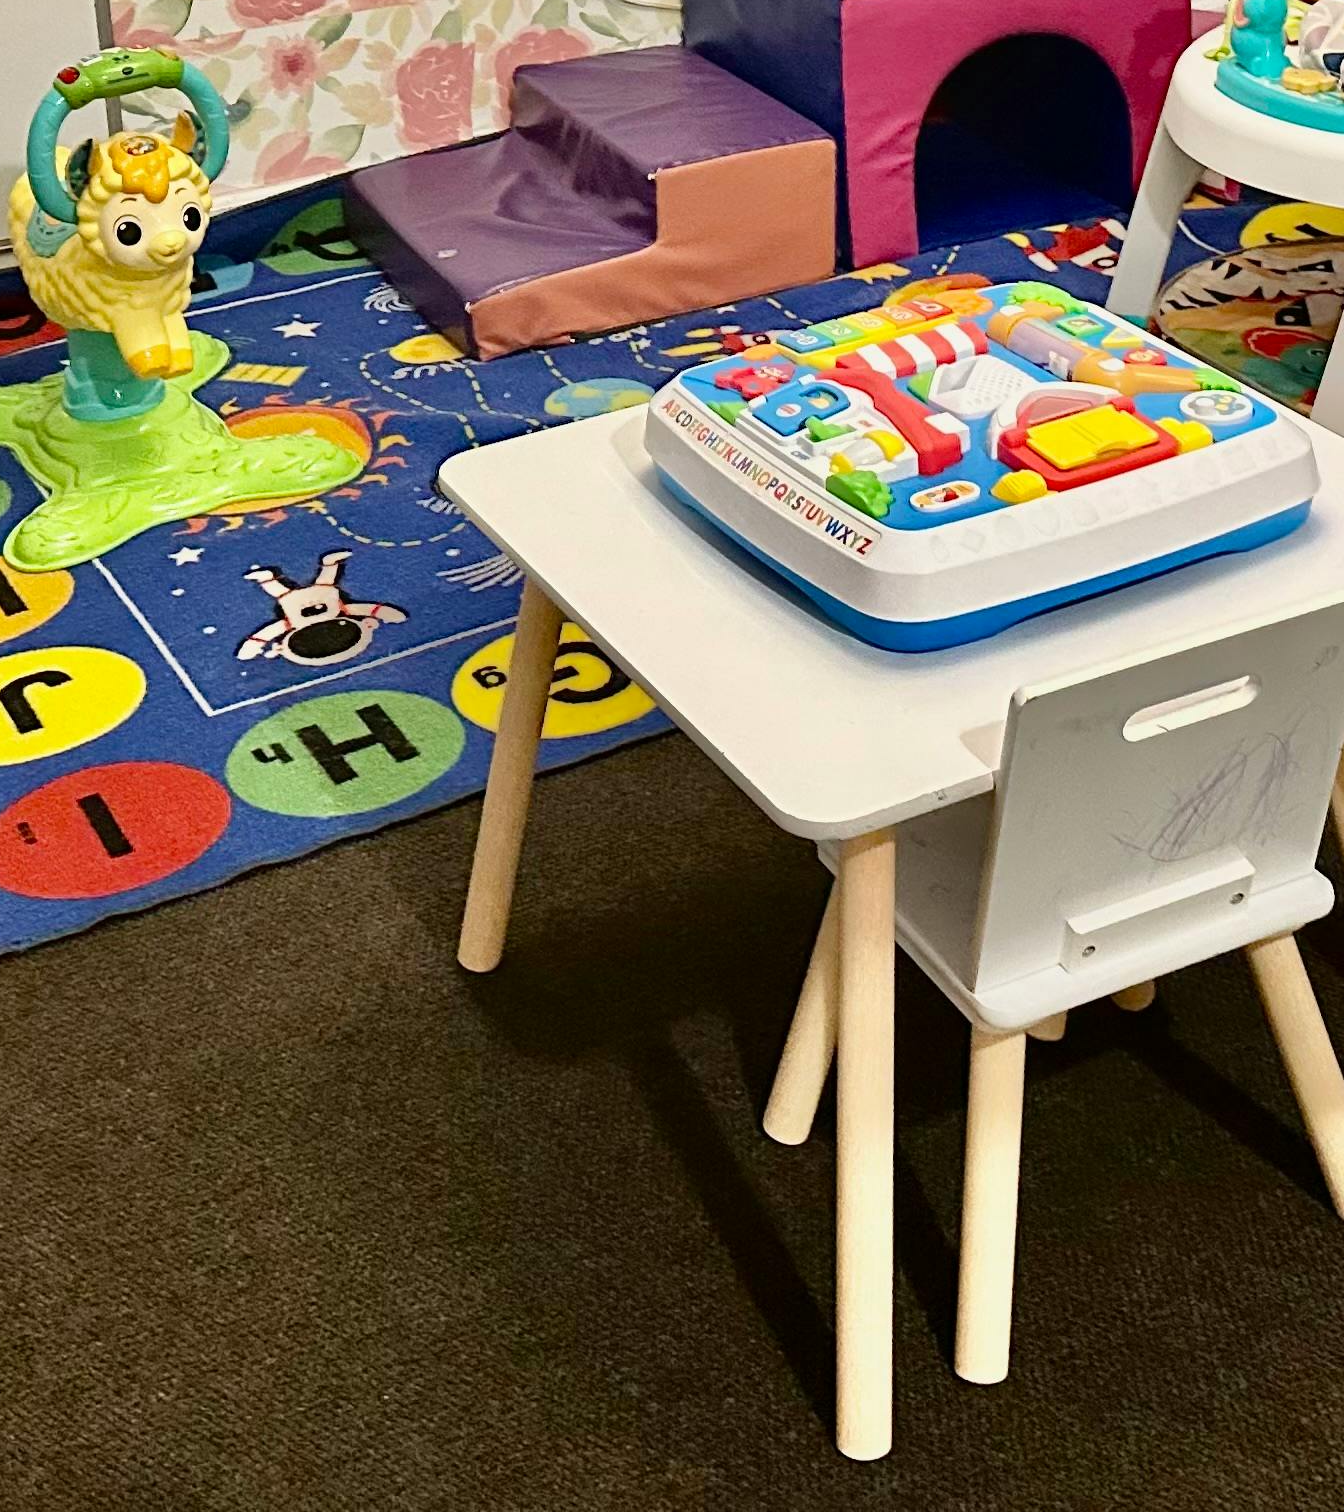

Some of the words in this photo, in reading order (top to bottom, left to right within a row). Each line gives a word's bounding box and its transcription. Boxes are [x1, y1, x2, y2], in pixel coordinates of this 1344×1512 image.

[662, 399, 873, 556] ABCDEFGHIJKLMNOPQRSTUVWXYZ
[294, 703, 421, 786] H
[76, 792, 134, 859] I
